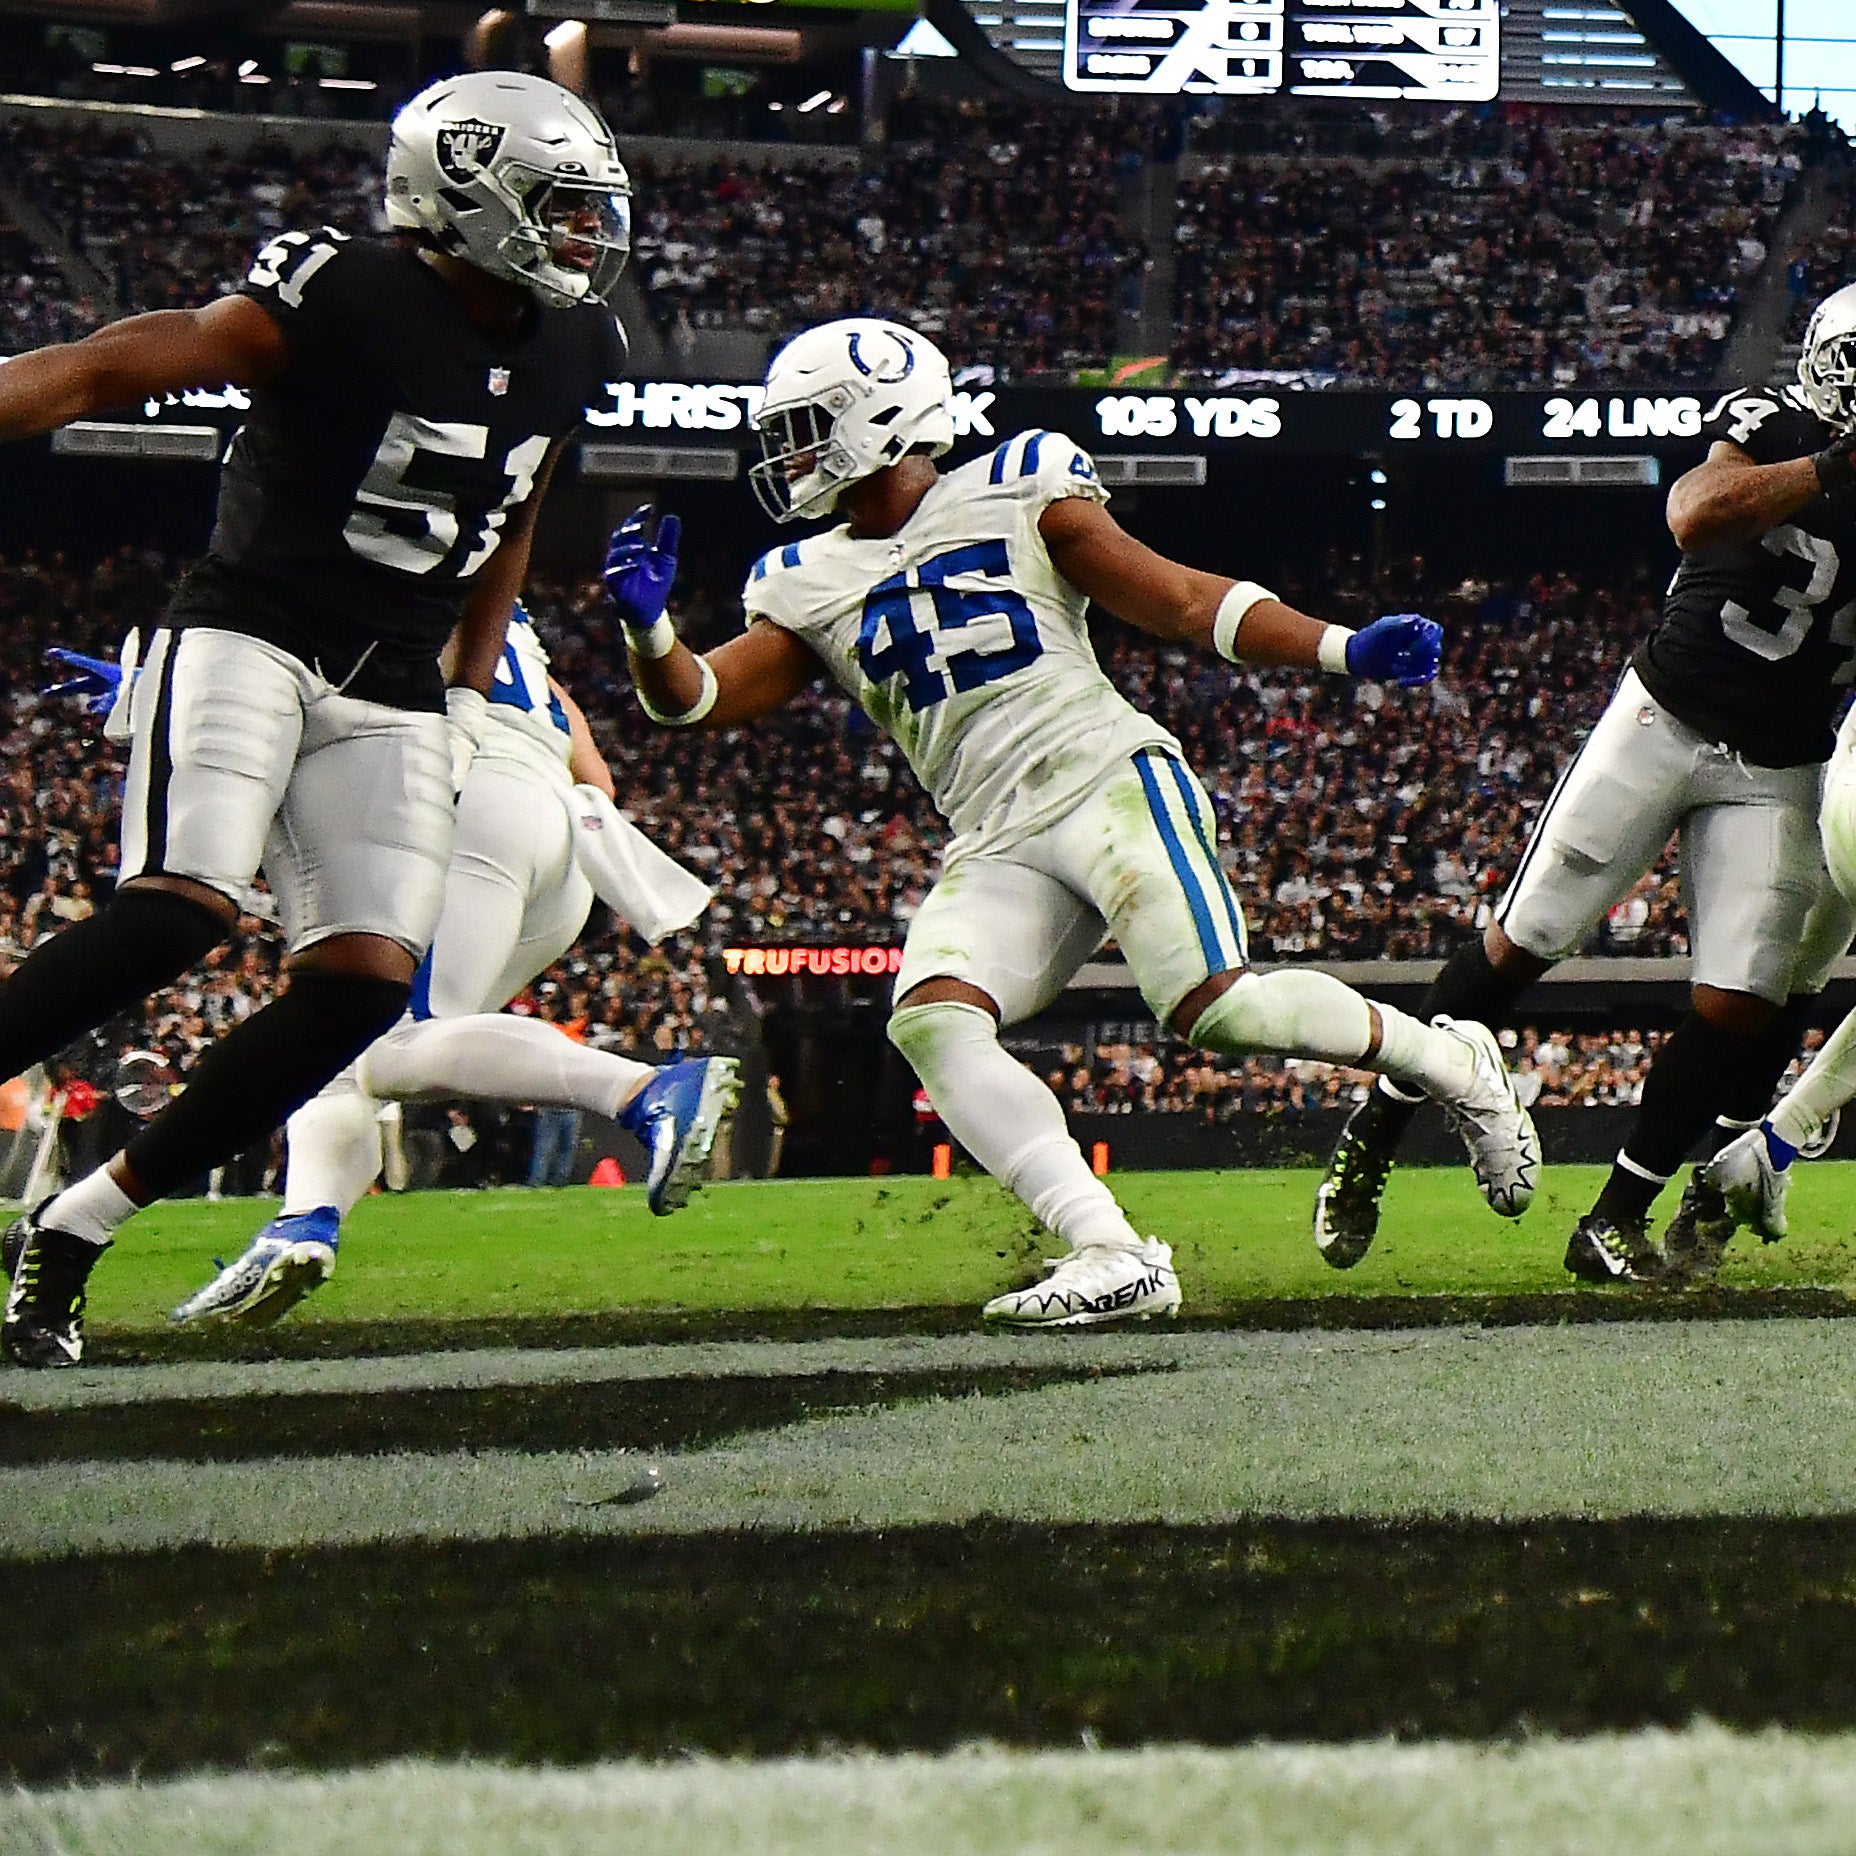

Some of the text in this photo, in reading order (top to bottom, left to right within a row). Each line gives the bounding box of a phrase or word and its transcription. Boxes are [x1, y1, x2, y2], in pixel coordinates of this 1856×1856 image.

[343, 411, 551, 578] 51
[1096, 396, 1703, 438] 105 YDS 2 TD 24 LNG
[856, 539, 1043, 713] 45
